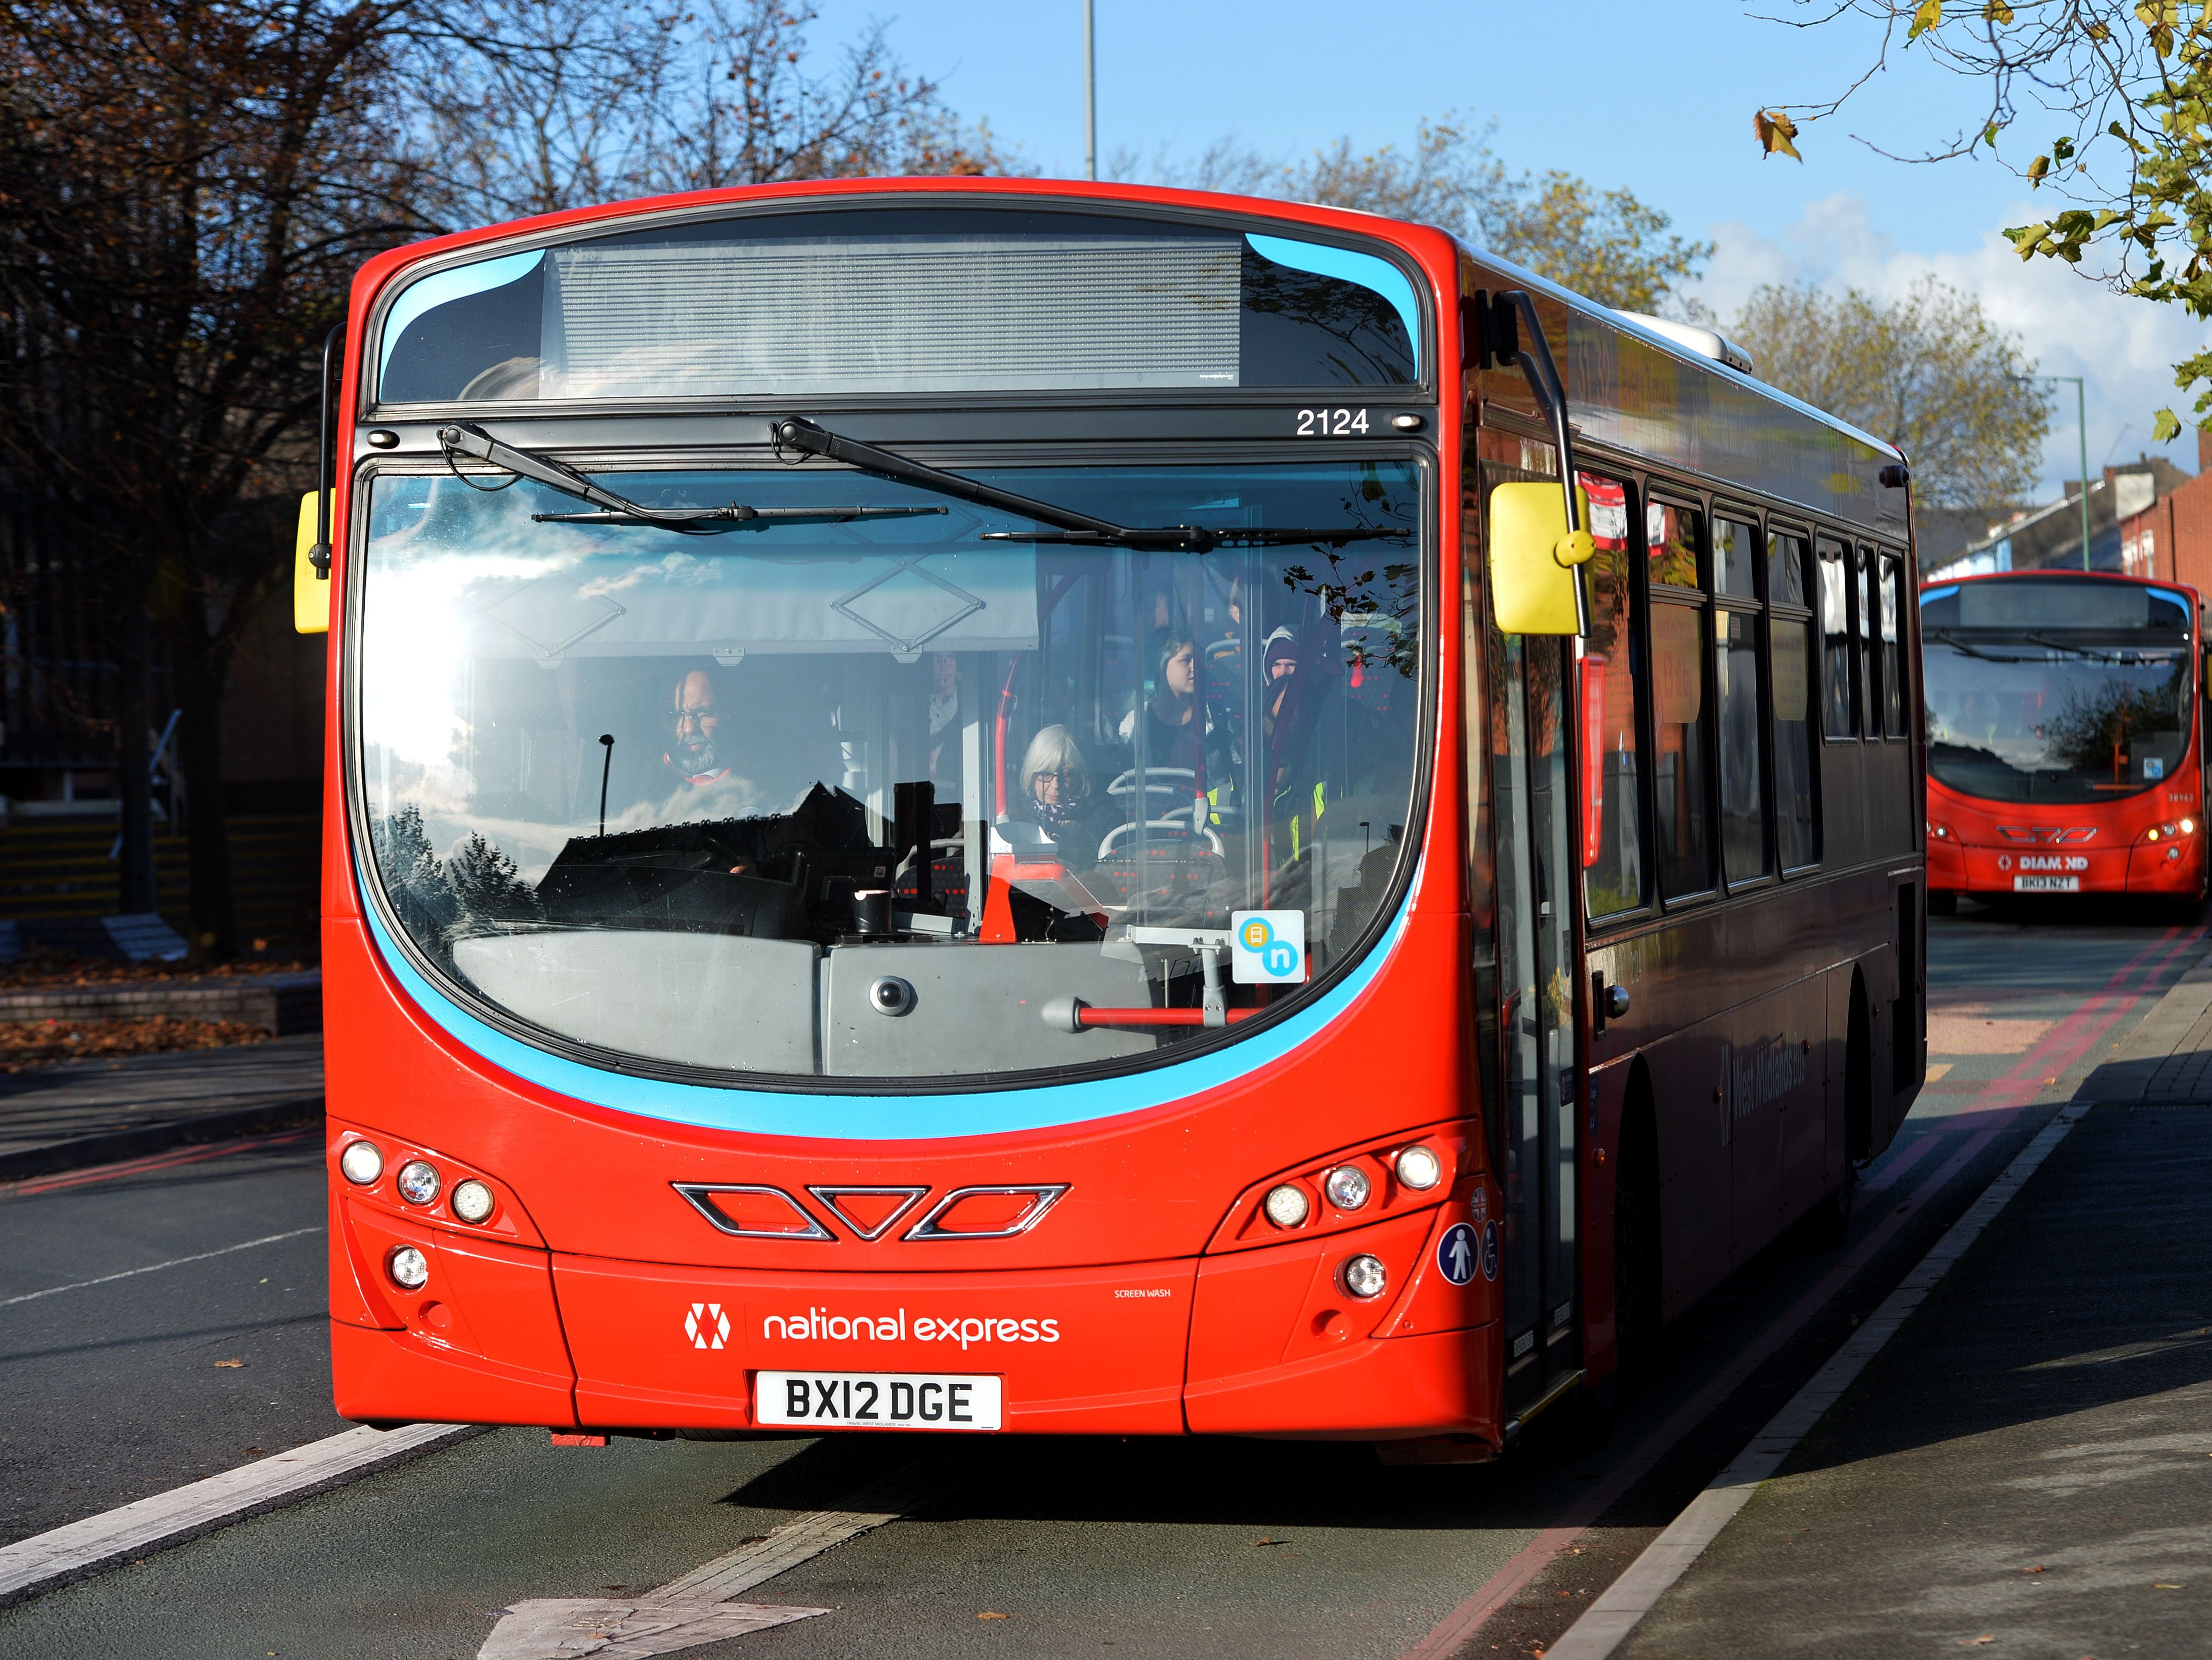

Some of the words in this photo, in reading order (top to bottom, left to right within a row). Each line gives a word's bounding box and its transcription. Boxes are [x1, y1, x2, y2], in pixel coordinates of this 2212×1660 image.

[1622, 364, 1644, 411] every
[1297, 408, 1369, 435] 2124
[2020, 856, 2088, 870] DIAMND
[2050, 877, 2071, 888] NZT
[1733, 1055, 1754, 1121] West
[1756, 1030, 1792, 1107] Midlands
[1793, 1030, 1805, 1086] Bus
[1114, 1290, 1145, 1298] SCREEN
[1146, 1289, 1171, 1297] WASH
[764, 1307, 906, 1341] national
[914, 1316, 1060, 1350] express
[786, 1380, 879, 1420] BX12
[890, 1382, 972, 1422] DGE
